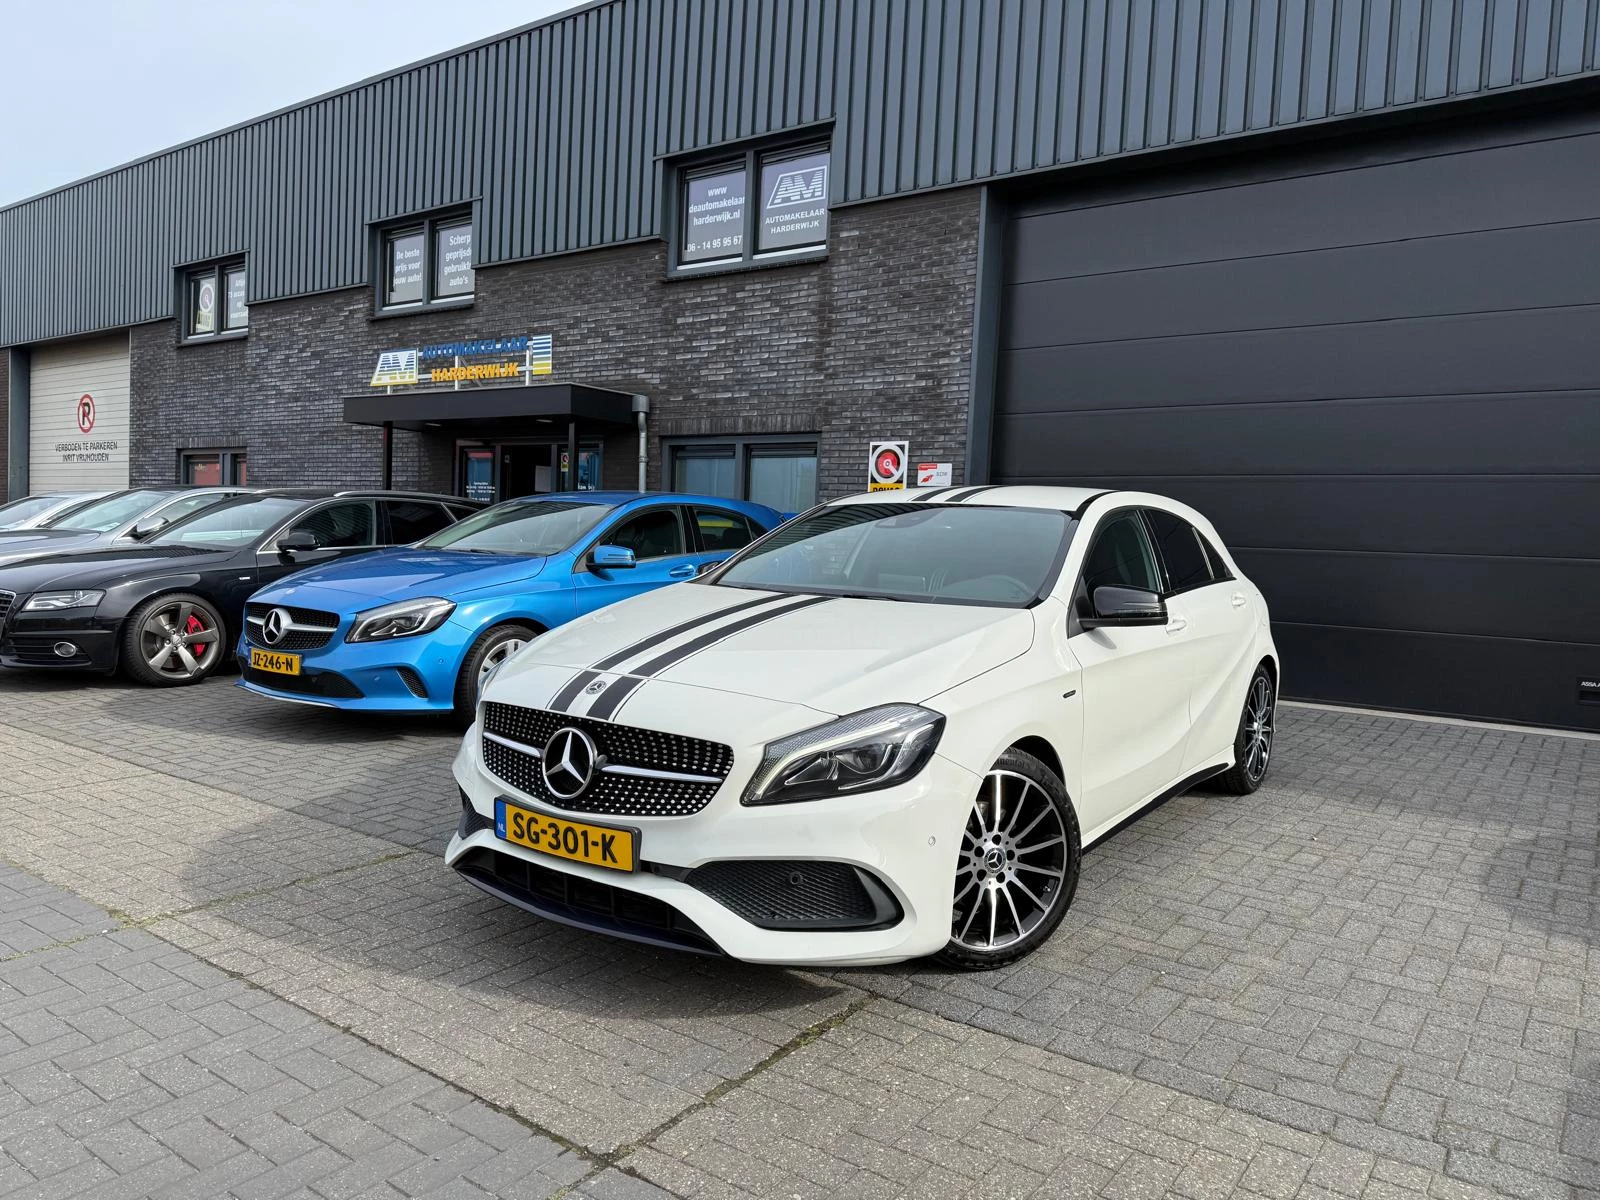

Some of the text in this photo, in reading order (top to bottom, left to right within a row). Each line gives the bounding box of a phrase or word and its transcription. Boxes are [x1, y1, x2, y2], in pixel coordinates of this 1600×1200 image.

[708, 186, 727, 197] www
[689, 196, 745, 213] deautomakelaar
[693, 210, 741, 226] harderwijk.nl
[765, 208, 825, 225] AUTOMAKELAAR
[770, 220, 820, 234] HARDERWIJK
[450, 234, 471, 246] Scherp
[687, 243, 696, 252] 06
[702, 241, 711, 249] 14
[712, 238, 721, 248] 95
[722, 236, 732, 247] 95
[733, 235, 742, 245] 67
[446, 247, 471, 262] geprijsd
[450, 275, 468, 286] auto's
[422, 336, 528, 359] AUTOMAKELAAR
[431, 362, 519, 382] HARDERWIJK
[55, 441, 118, 452] VERBODEN TE PARKEREN
[253, 652, 293, 671] JZ-246-N
[512, 812, 618, 864] SG-301-K
